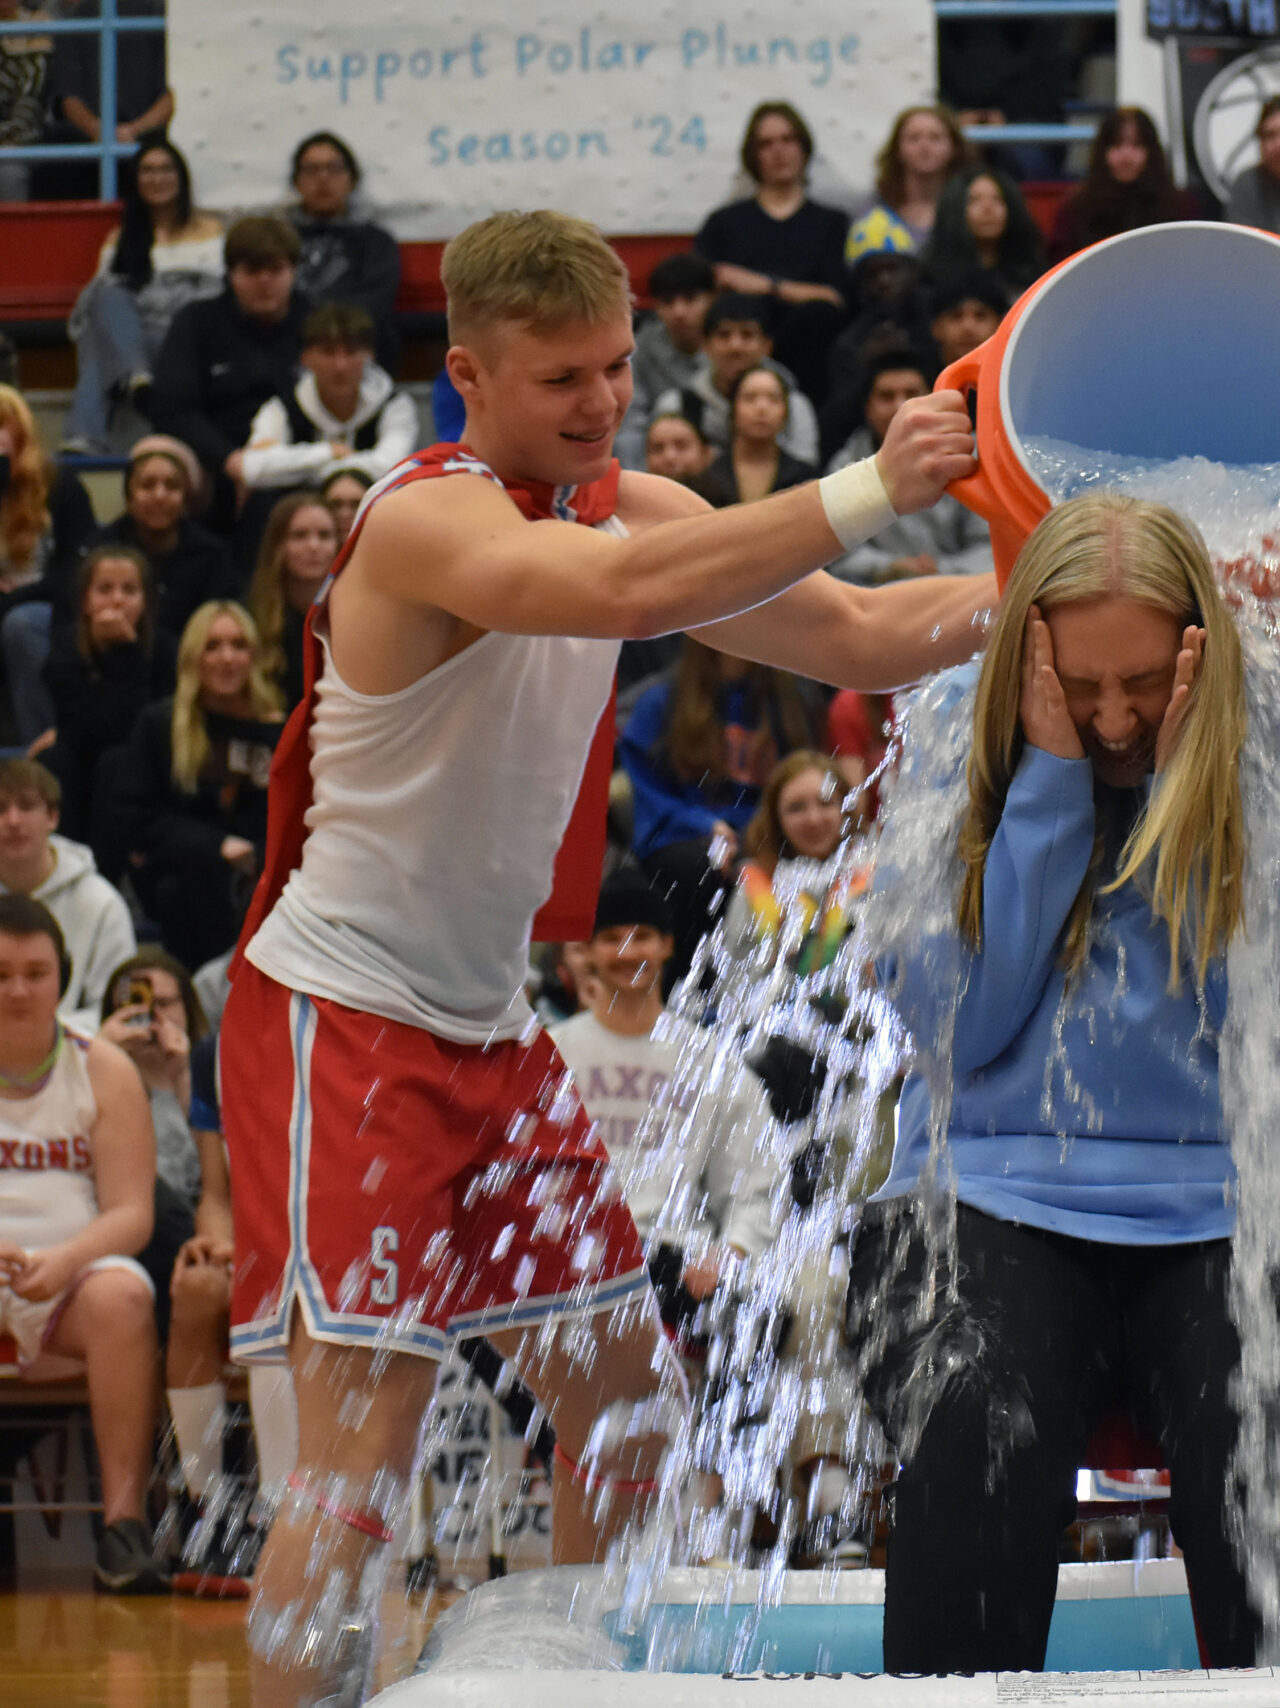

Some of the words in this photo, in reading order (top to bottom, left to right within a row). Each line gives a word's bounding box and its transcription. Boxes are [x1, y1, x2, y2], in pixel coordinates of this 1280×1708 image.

[277, 31, 488, 104] Support
[515, 25, 655, 77] Polar
[680, 20, 861, 87] Plunge
[428, 125, 609, 167] Season
[370, 1225, 400, 1305] S
